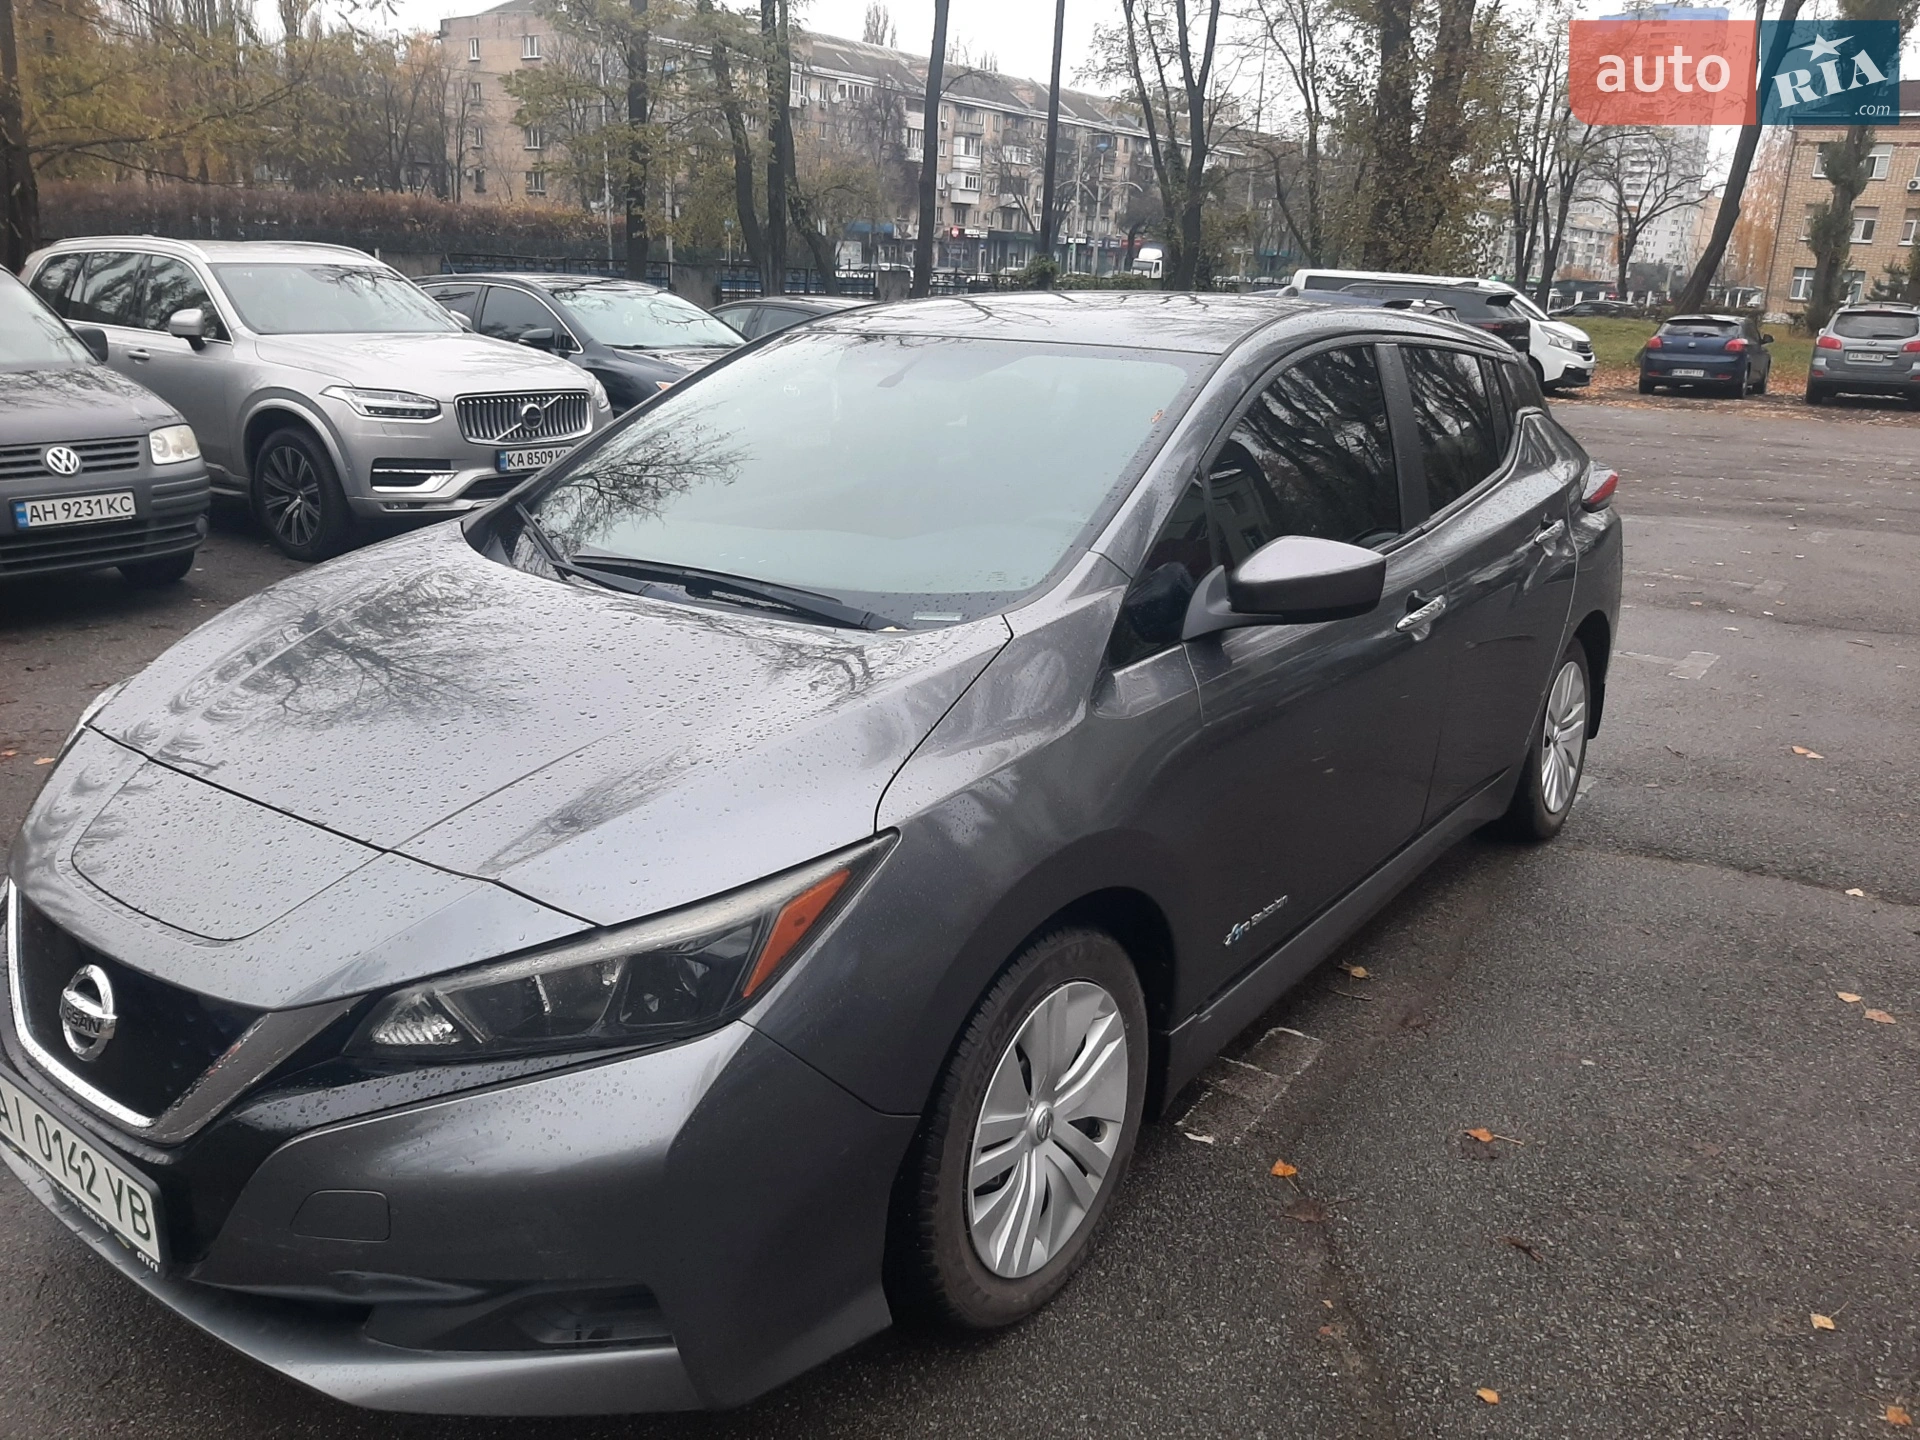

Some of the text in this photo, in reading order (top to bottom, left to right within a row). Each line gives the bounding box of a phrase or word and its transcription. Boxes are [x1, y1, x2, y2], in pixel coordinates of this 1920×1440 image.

[507, 453, 525, 467] KA
[527, 450, 553, 466] 8509
[29, 496, 133, 522] AH 9231 KC
[34, 1113, 101, 1204] 0142
[105, 1166, 151, 1242] YB
